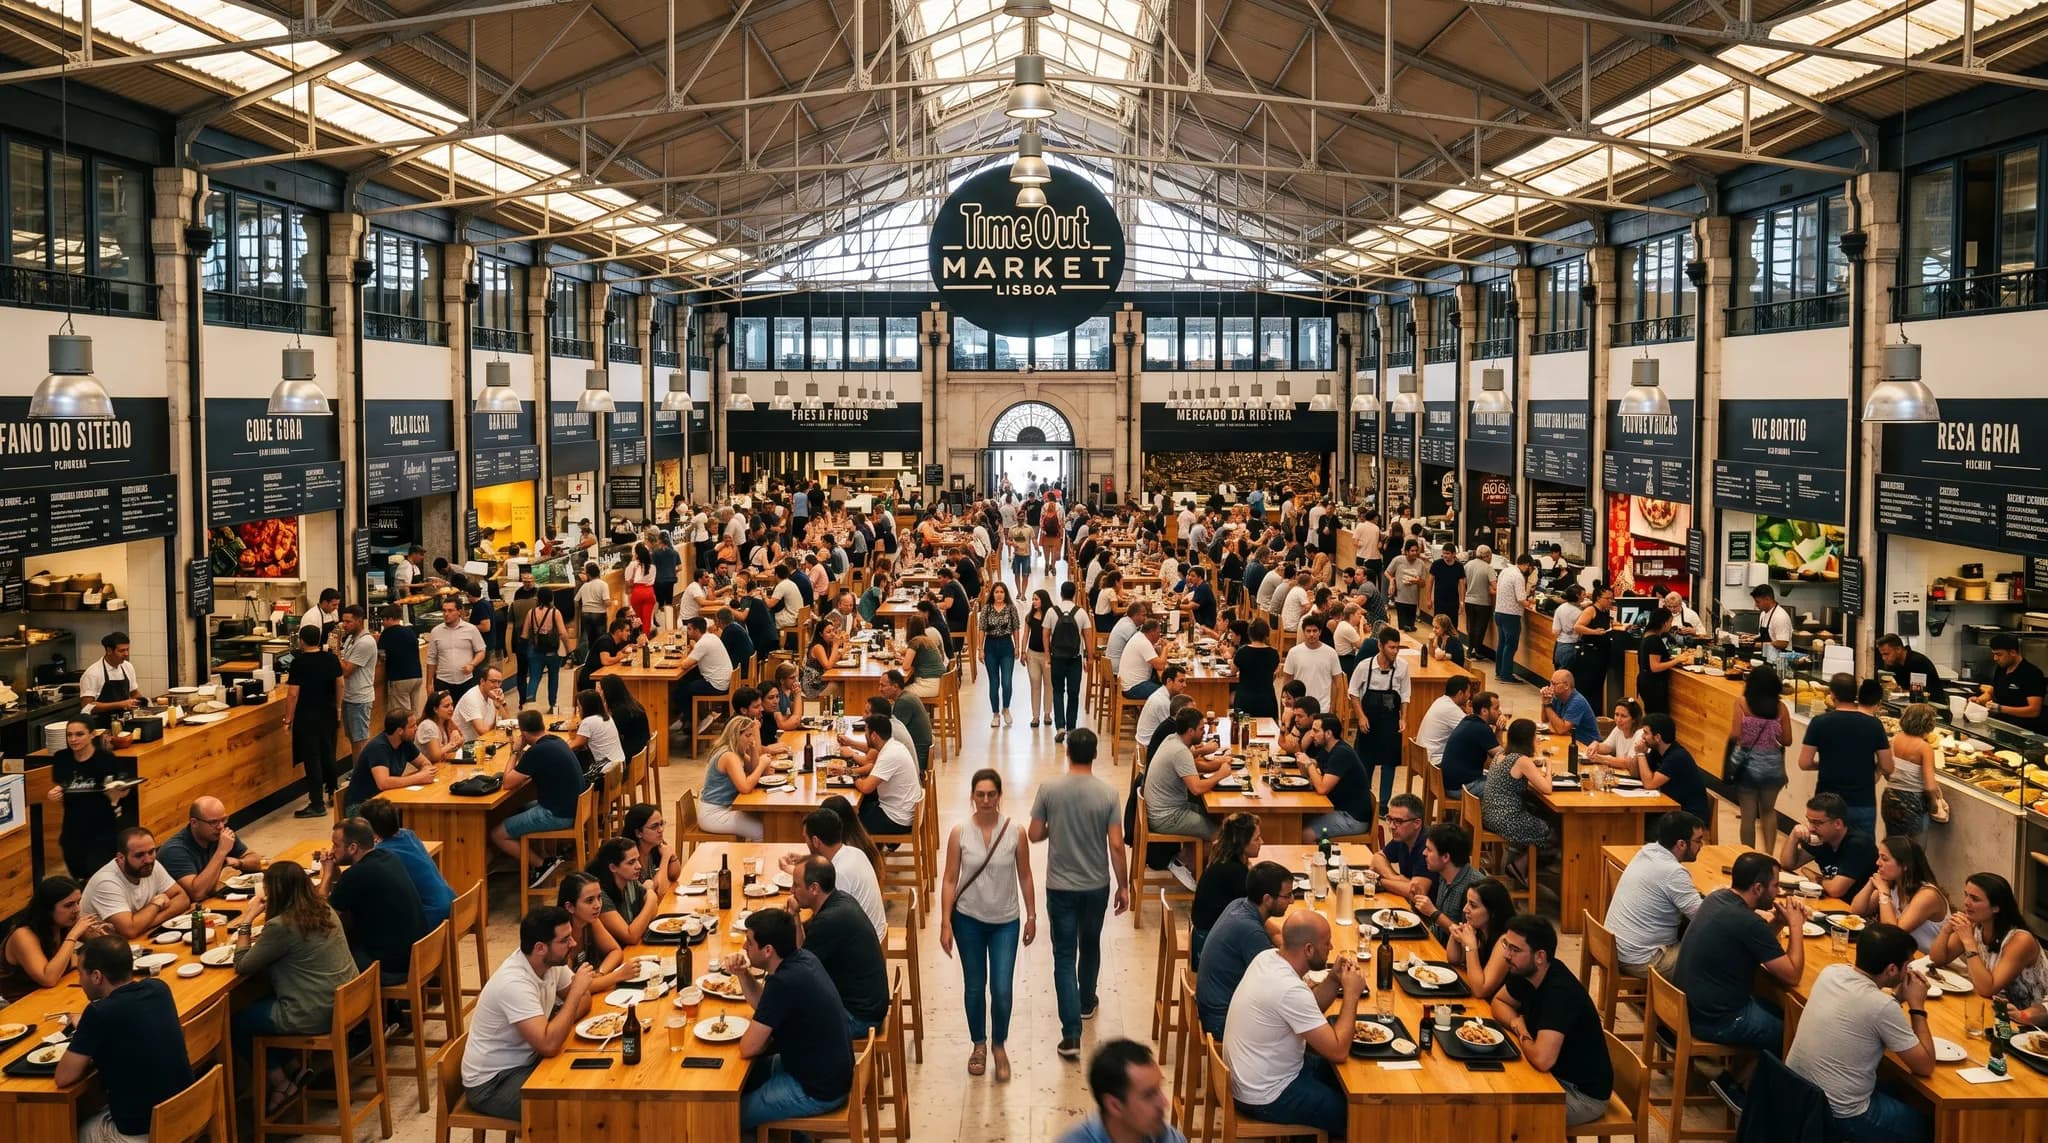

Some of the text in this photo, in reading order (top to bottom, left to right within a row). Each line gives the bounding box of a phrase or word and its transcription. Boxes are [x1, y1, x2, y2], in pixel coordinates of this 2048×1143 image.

[960, 203, 1091, 250] Time Out
[942, 256, 1111, 279] MARKET
[996, 284, 1057, 296] LISBOA
[1176, 409, 1227, 421] MERCADO
[1231, 409, 1245, 421] DA
[49, 422, 71, 452] DO
[1937, 422, 2021, 454] RESA GRIA
